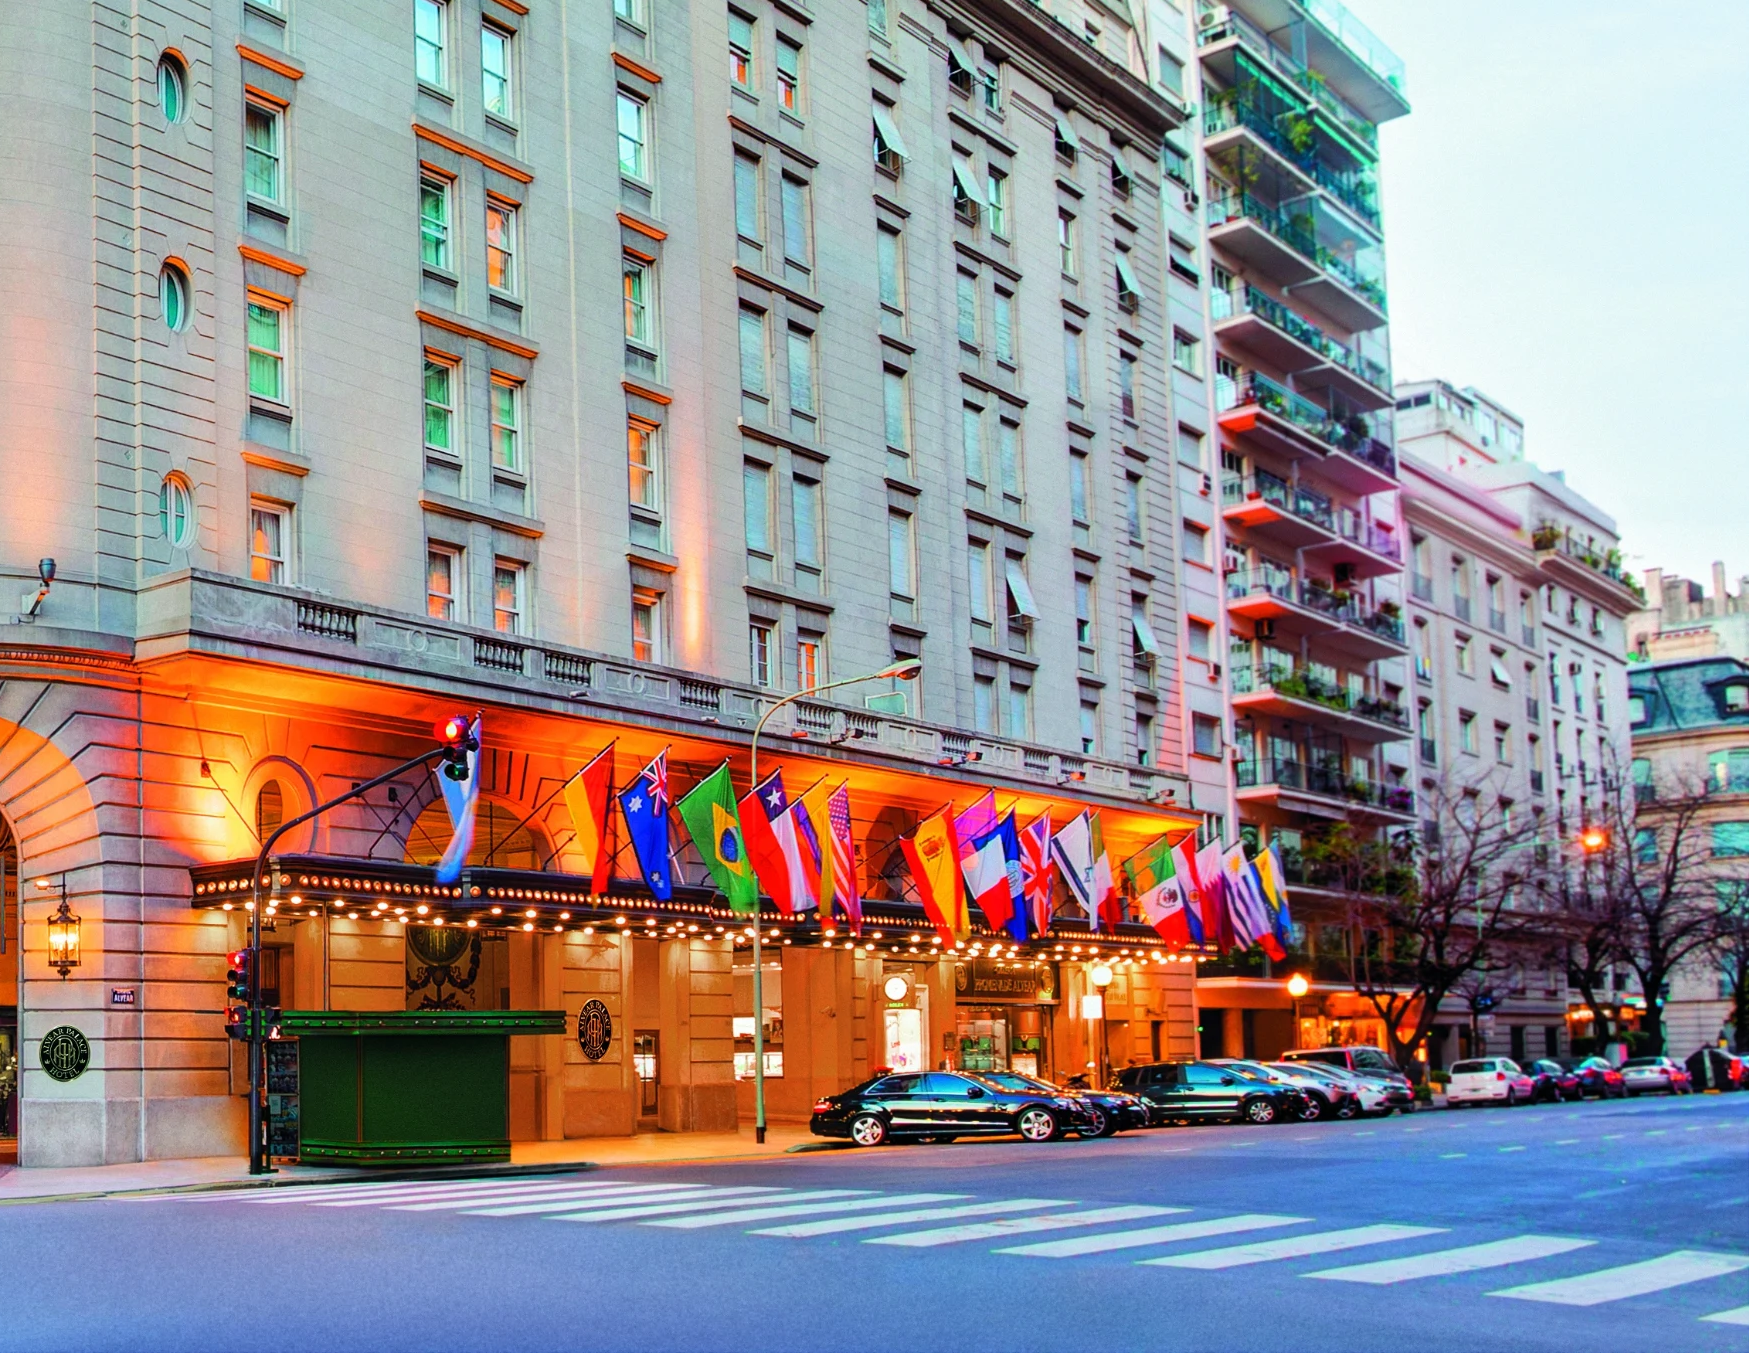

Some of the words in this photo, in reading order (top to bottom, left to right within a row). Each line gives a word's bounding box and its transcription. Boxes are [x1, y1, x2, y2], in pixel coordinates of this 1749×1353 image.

[114, 994, 133, 1002] ALVEAR
[43, 1028, 64, 1055] ALVEAR
[66, 1028, 88, 1054] PALACE
[584, 1046, 606, 1058] HOTEL
[50, 1067, 80, 1079] HOTEL
